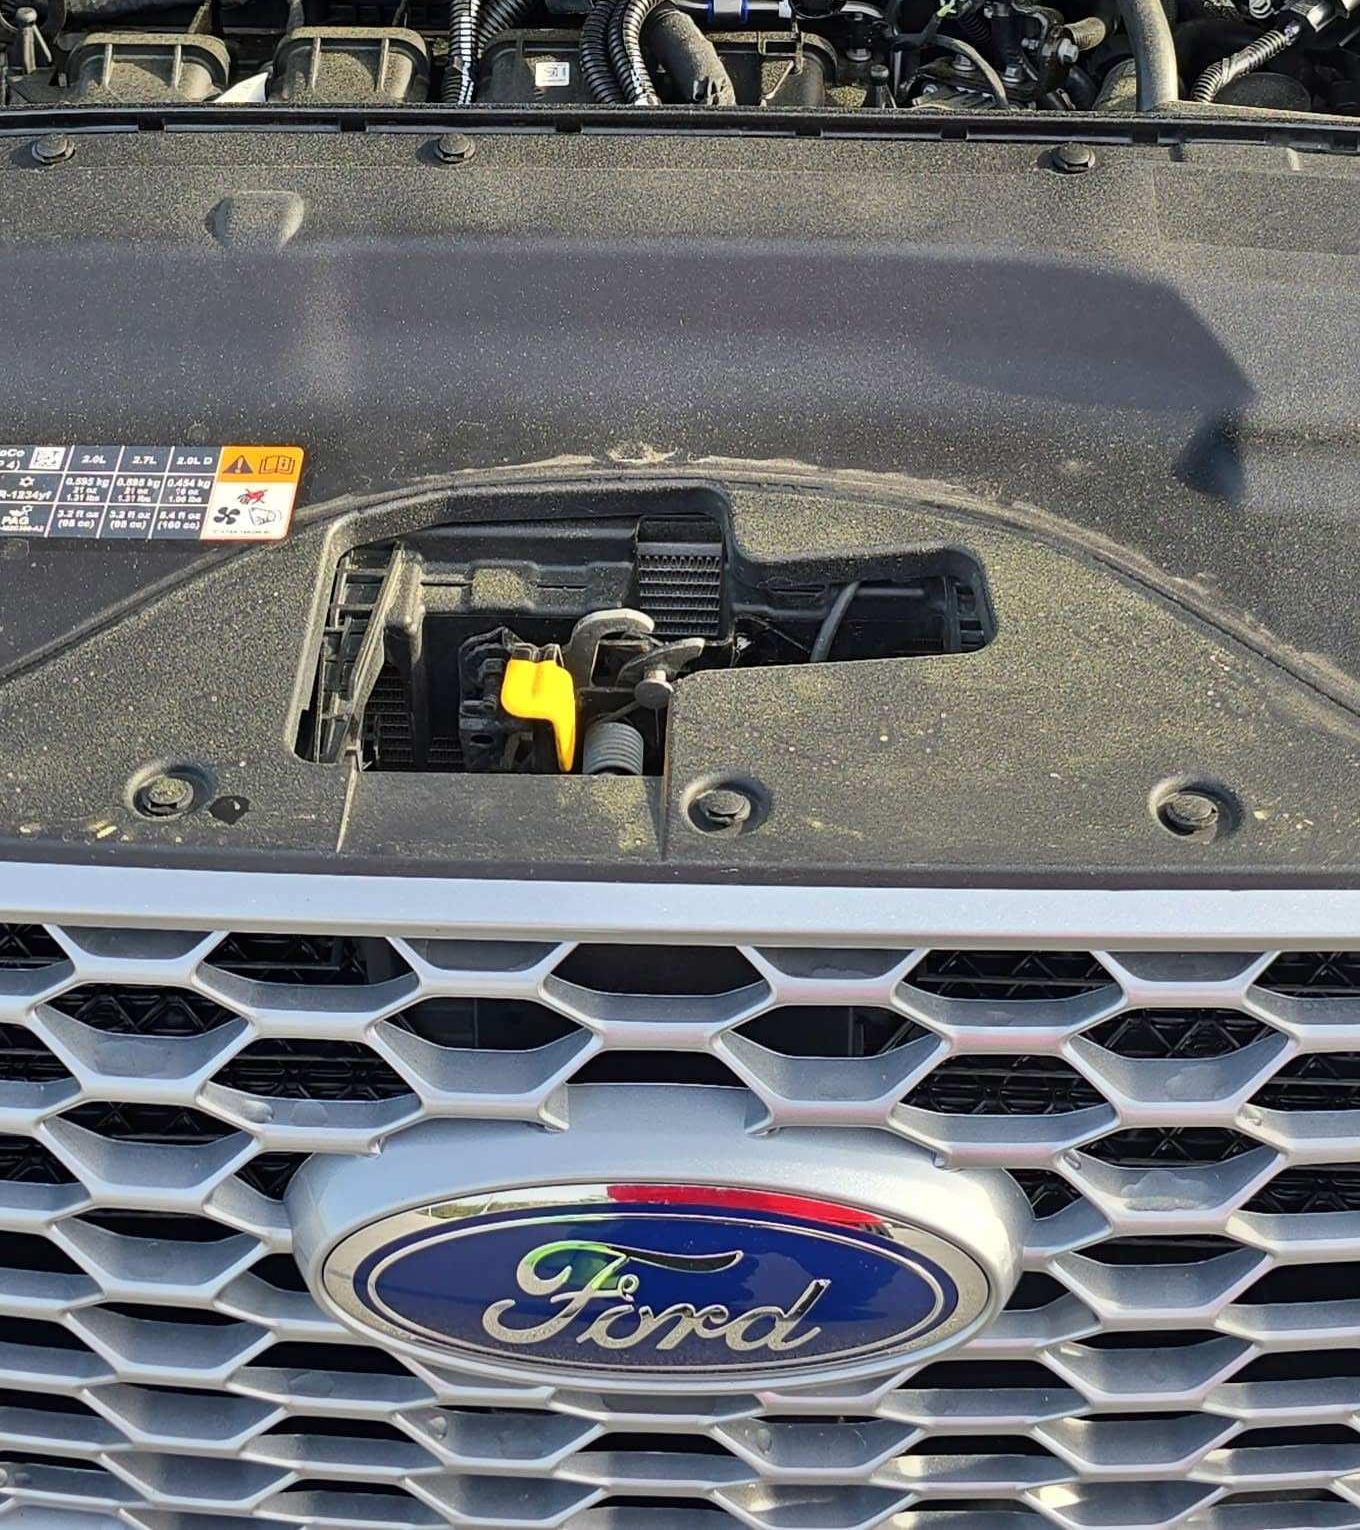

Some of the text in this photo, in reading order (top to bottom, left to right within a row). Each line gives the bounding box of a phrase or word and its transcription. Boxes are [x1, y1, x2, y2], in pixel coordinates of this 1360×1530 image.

[81, 455, 107, 464] 2.0L
[132, 455, 157, 465] 2.7L
[177, 456, 213, 465] 2.0L D
[6, 460, 20, 470] 4)
[96, 478, 110, 489] kg
[147, 478, 161, 489] kg
[167, 478, 211, 489] 0.454 kg
[56, 509, 73, 518] 3.2
[87, 510, 99, 518] oz
[138, 511, 151, 519] oz
[188, 512, 201, 520] oz
[1, 516, 30, 525] PAG
[77, 519, 95, 529] cc)
[130, 520, 146, 530] cc)
[183, 521, 201, 530] cc)
[481, 1239, 832, 1353] Ford
